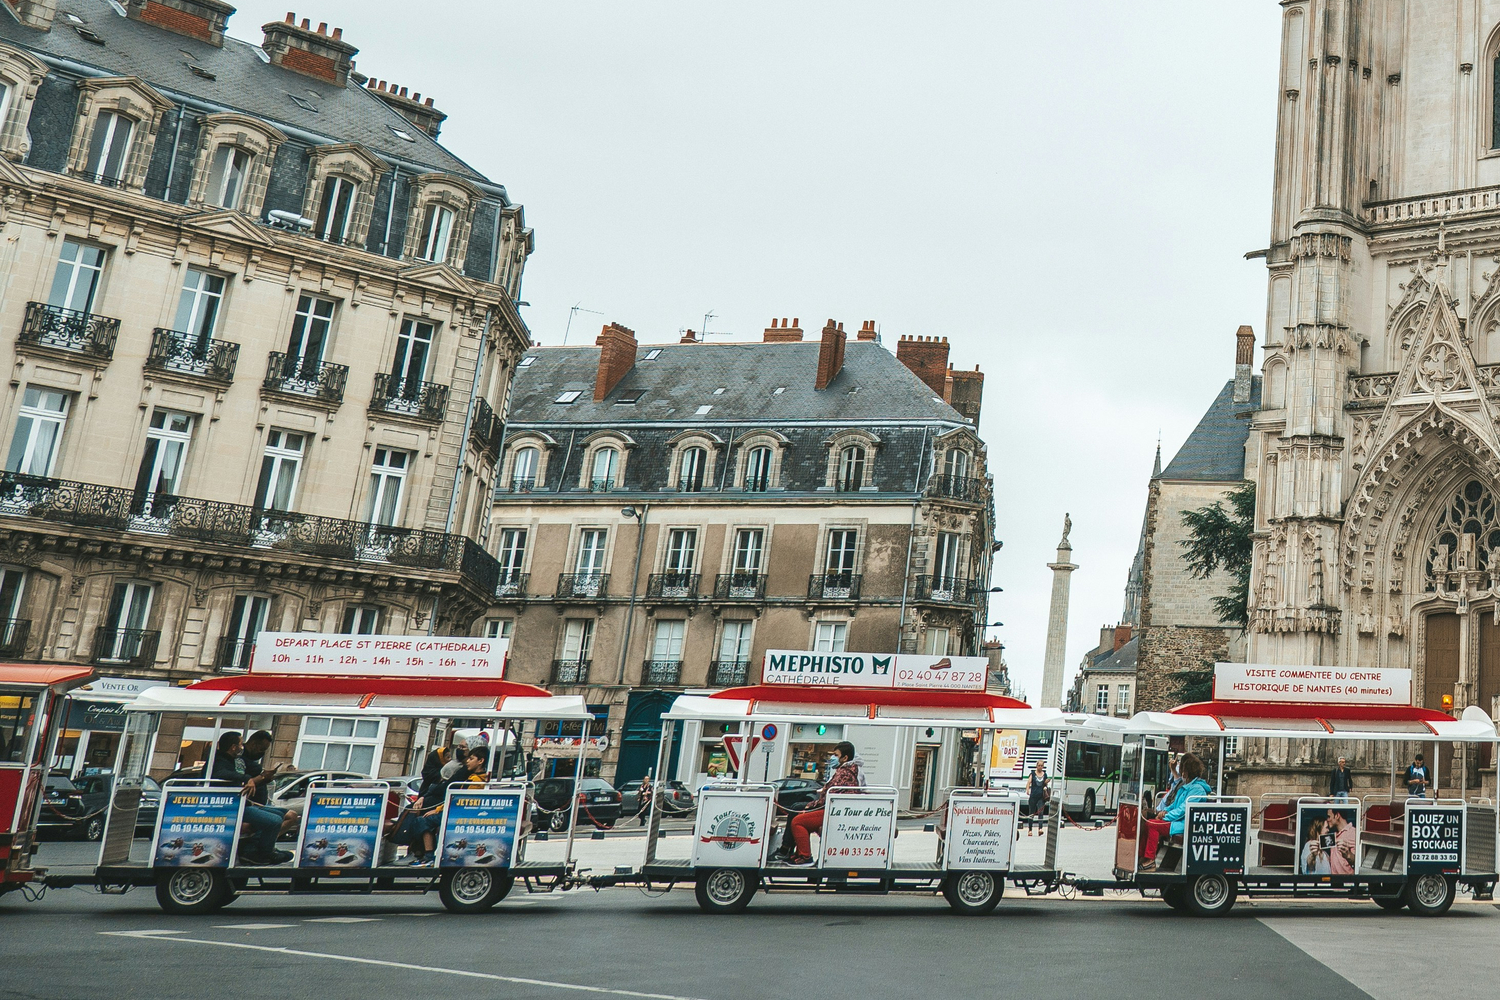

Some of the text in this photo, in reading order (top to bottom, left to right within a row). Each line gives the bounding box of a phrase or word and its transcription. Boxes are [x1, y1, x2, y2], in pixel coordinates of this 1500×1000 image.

[276, 638, 490, 654] DEPART PLACE ST PIERRE (CATHEDRALE)
[272, 654, 290, 663] 10h
[306, 655, 324, 664] 11h
[340, 655, 357, 665] 12h
[373, 656, 391, 665] 14h
[406, 657, 424, 666] 15h
[439, 657, 457, 667] 16h
[471, 658, 489, 667] 17h
[769, 655, 864, 674] MEPHISTO
[766, 673, 839, 685] CATHÉDRALE
[899, 670, 981, 682] 02 40 47 87 28
[1245, 669, 1381, 681] VISITE COMMENTEE DU CENTRE
[1233, 683, 1289, 693] HISTORIQUE
[1307, 685, 1342, 693] NANTES
[1345, 685, 1358, 695] (40
[1361, 686, 1392, 696] minutes)
[830, 807, 892, 816] La Tour de Pise
[954, 806, 1014, 816] Spécialités Italiennes
[966, 816, 1000, 826] à Emporter
[1193, 812, 1242, 822] FAITES DE
[1412, 814, 1458, 824] LOUEZ UN
[170, 824, 181, 832] 06
[183, 824, 191, 832] 19
[315, 825, 368, 833] 06 19 54 66 78
[455, 826, 506, 834] 06 19 54 66 78
[1192, 824, 1241, 834] LA PLACE
[1412, 826, 1458, 838] BOX DE
[1412, 840, 1458, 849] STOCKAGE
[828, 848, 885, 856] 02 40 33 25 74
[1192, 845, 1220, 861] VIE
